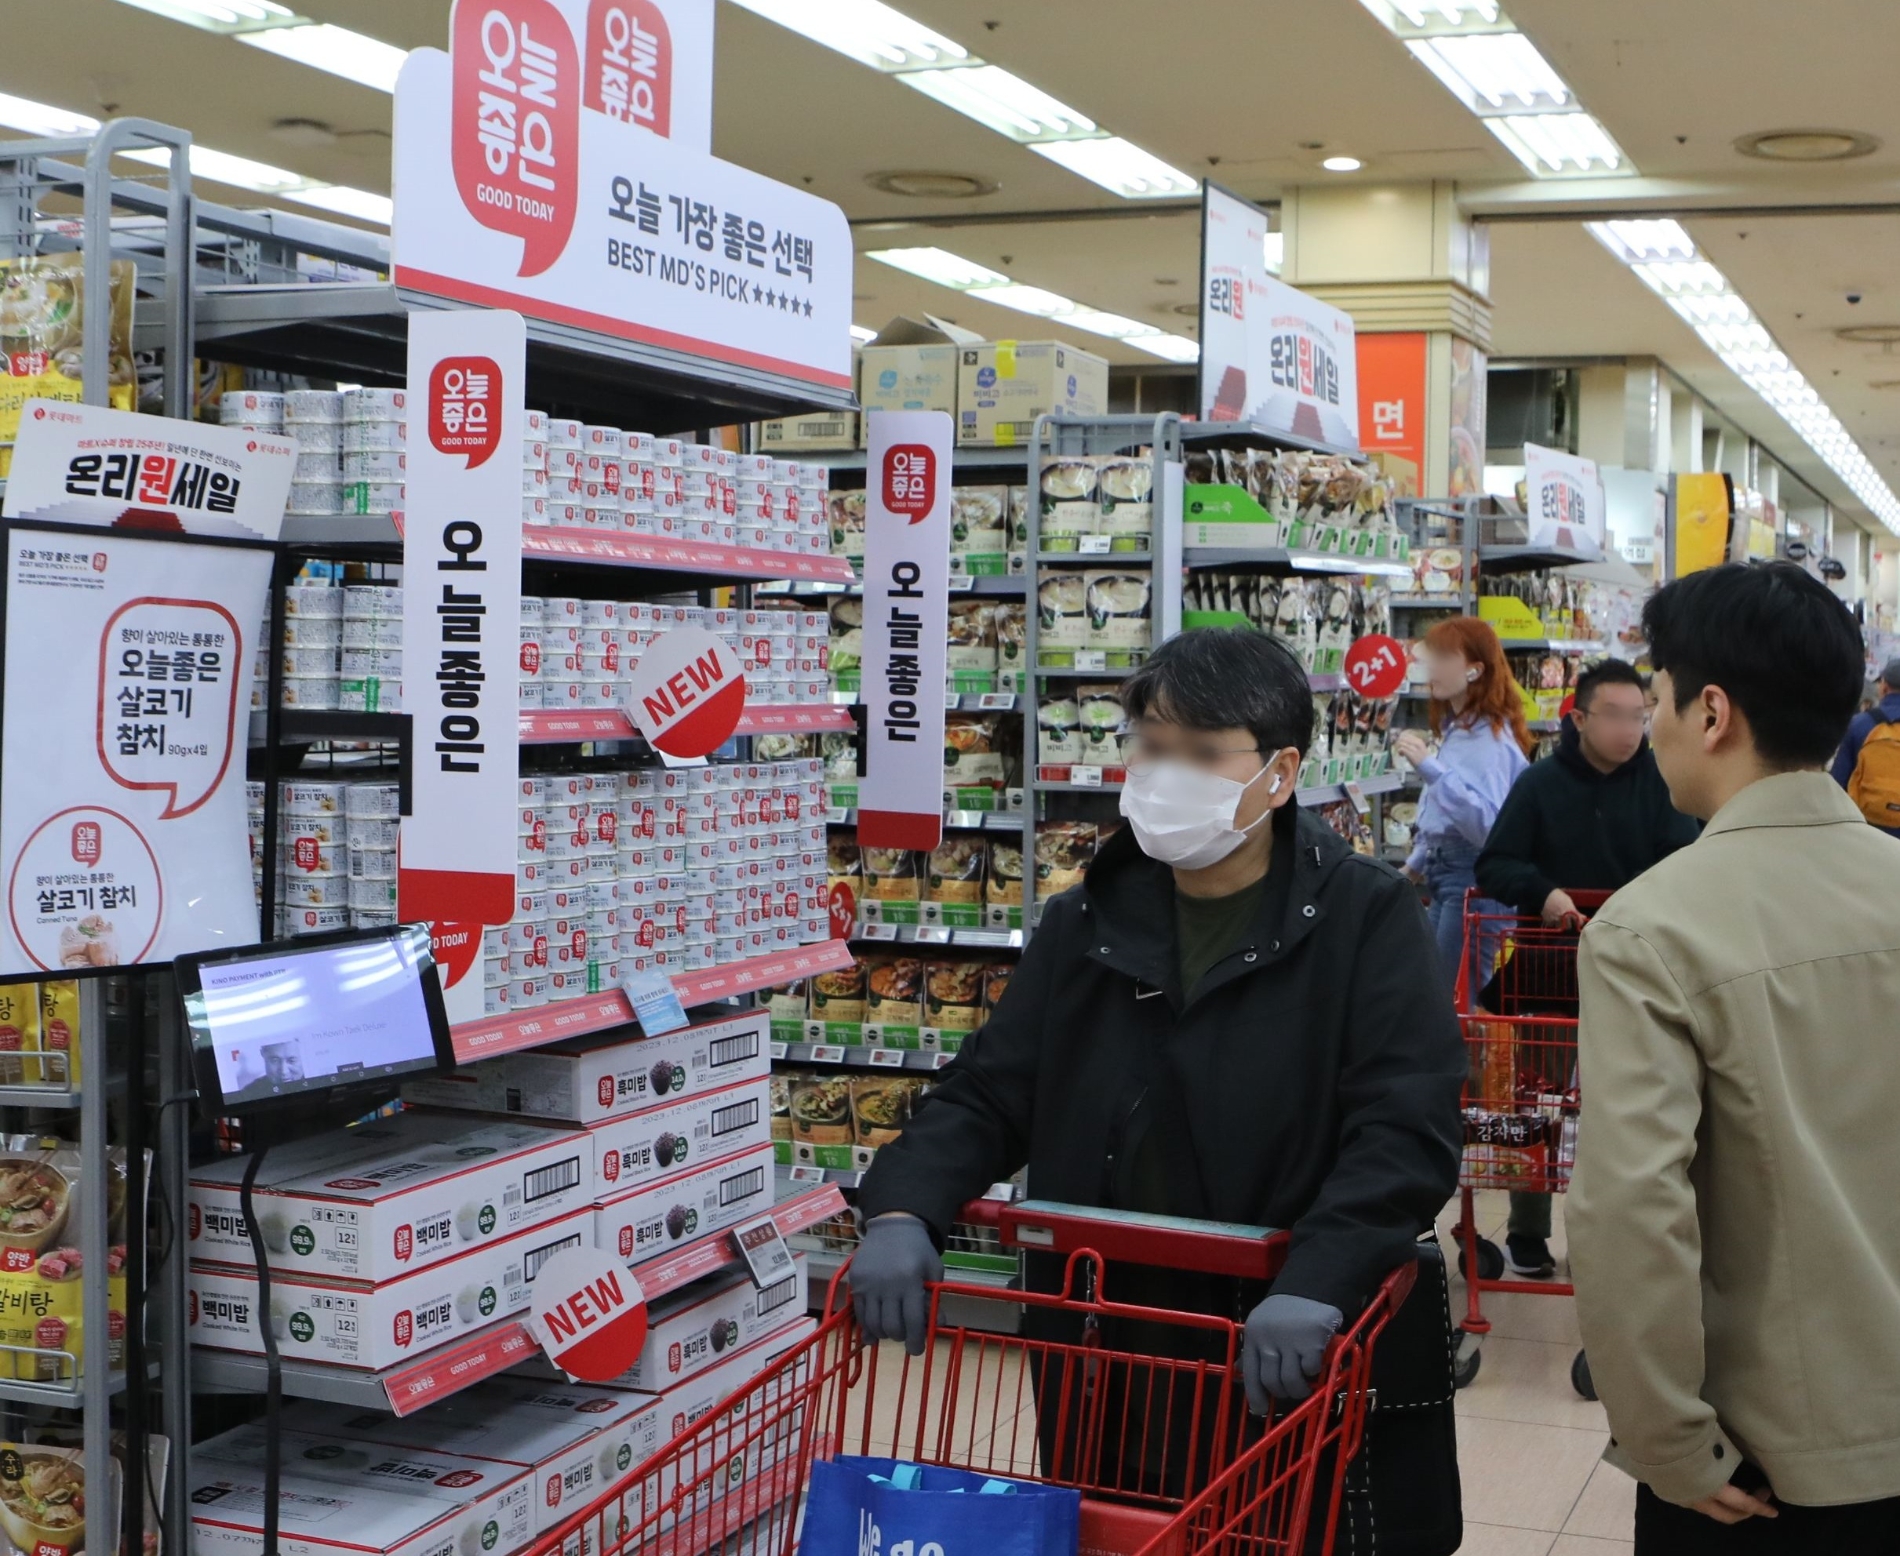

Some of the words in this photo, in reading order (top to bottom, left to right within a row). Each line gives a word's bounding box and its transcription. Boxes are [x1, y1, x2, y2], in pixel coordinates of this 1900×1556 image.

[480, 9, 557, 108] 오늘
[477, 89, 556, 191] 좋은
[476, 184, 512, 211] GOOD
[514, 194, 555, 223] TODAY
[608, 176, 662, 237] 오늘
[668, 195, 717, 253] 가장
[722, 213, 766, 264] 좋은
[771, 229, 814, 284] 선택
[607, 239, 655, 278] BEST
[660, 254, 705, 293] MD'S
[710, 270, 750, 304] PICK
[1210, 278, 1245, 320] 온리원
[443, 368, 489, 399] 오늘
[1270, 334, 1339, 405] 온리원세일
[442, 401, 488, 434] 좋은
[1373, 399, 1404, 439] 면
[442, 437, 462, 445] GOOD
[463, 437, 487, 445] TODAY
[893, 452, 927, 476] 오늘
[65, 453, 241, 514] 온리원세일
[892, 474, 926, 500] 좋은
[122, 629, 143, 643] 향이
[146, 630, 190, 645] 살아있는
[192, 632, 225, 648] 통통한
[435, 520, 487, 773] 오늘좋은
[884, 561, 924, 742] 오늘좋은
[118, 649, 221, 683] 오늘좋은
[1353, 645, 1398, 687] 2+1
[117, 686, 192, 718] 살코기
[643, 647, 724, 727] NEW
[116, 724, 165, 756] 참치
[55, 873, 88, 886] 살아있는
[36, 889, 94, 913] 살코기
[99, 885, 136, 908] 참치
[441, 931, 468, 948] TODAY
[229, 971, 258, 983] PAYMENT
[469, 1036, 486, 1047] GOOD
[486, 1032, 503, 1044] TODAY
[617, 1075, 647, 1096] 흑미밥
[622, 1147, 651, 1169] 흑미밥
[204, 1214, 249, 1237] 백미밥
[416, 1219, 451, 1245] 백미밥
[7, 1251, 30, 1267] 양반
[202, 1300, 249, 1324] 백미밥
[416, 1303, 451, 1330] 백미밥
[543, 1269, 625, 1345] NEW
[501, 1336, 526, 1353] 오늘좋은
[450, 1360, 469, 1376] GOOD
[469, 1353, 487, 1369] TODAY
[409, 1375, 435, 1395] 오늘좋은
[858, 1508, 881, 1556] We
